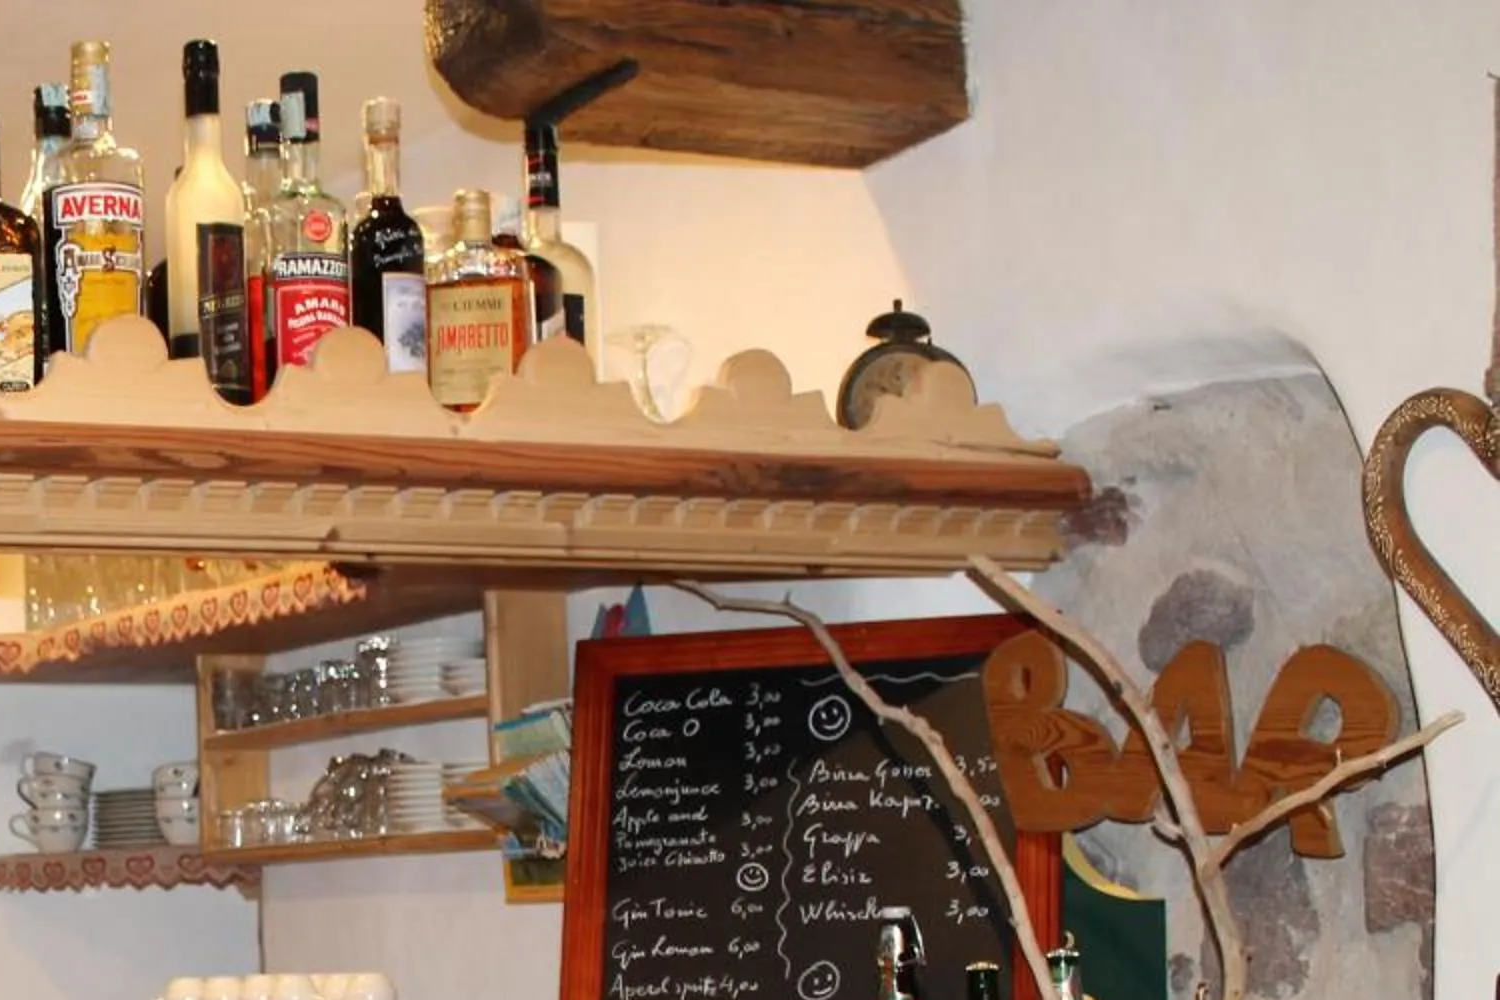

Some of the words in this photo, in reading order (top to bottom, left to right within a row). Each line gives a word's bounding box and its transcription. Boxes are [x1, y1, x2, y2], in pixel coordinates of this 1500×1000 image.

[61, 194, 142, 219] AVERNA
[437, 322, 509, 354] AMARETTO
[623, 690, 682, 717] Coca
[685, 687, 732, 710] Cola
[622, 719, 672, 742] Coca
[982, 630, 1399, 859] BAR
[744, 773, 778, 795] 3,00
[945, 861, 989, 884] 3,00
[945, 900, 989, 925] 3,00
[727, 936, 761, 960] 6,00
